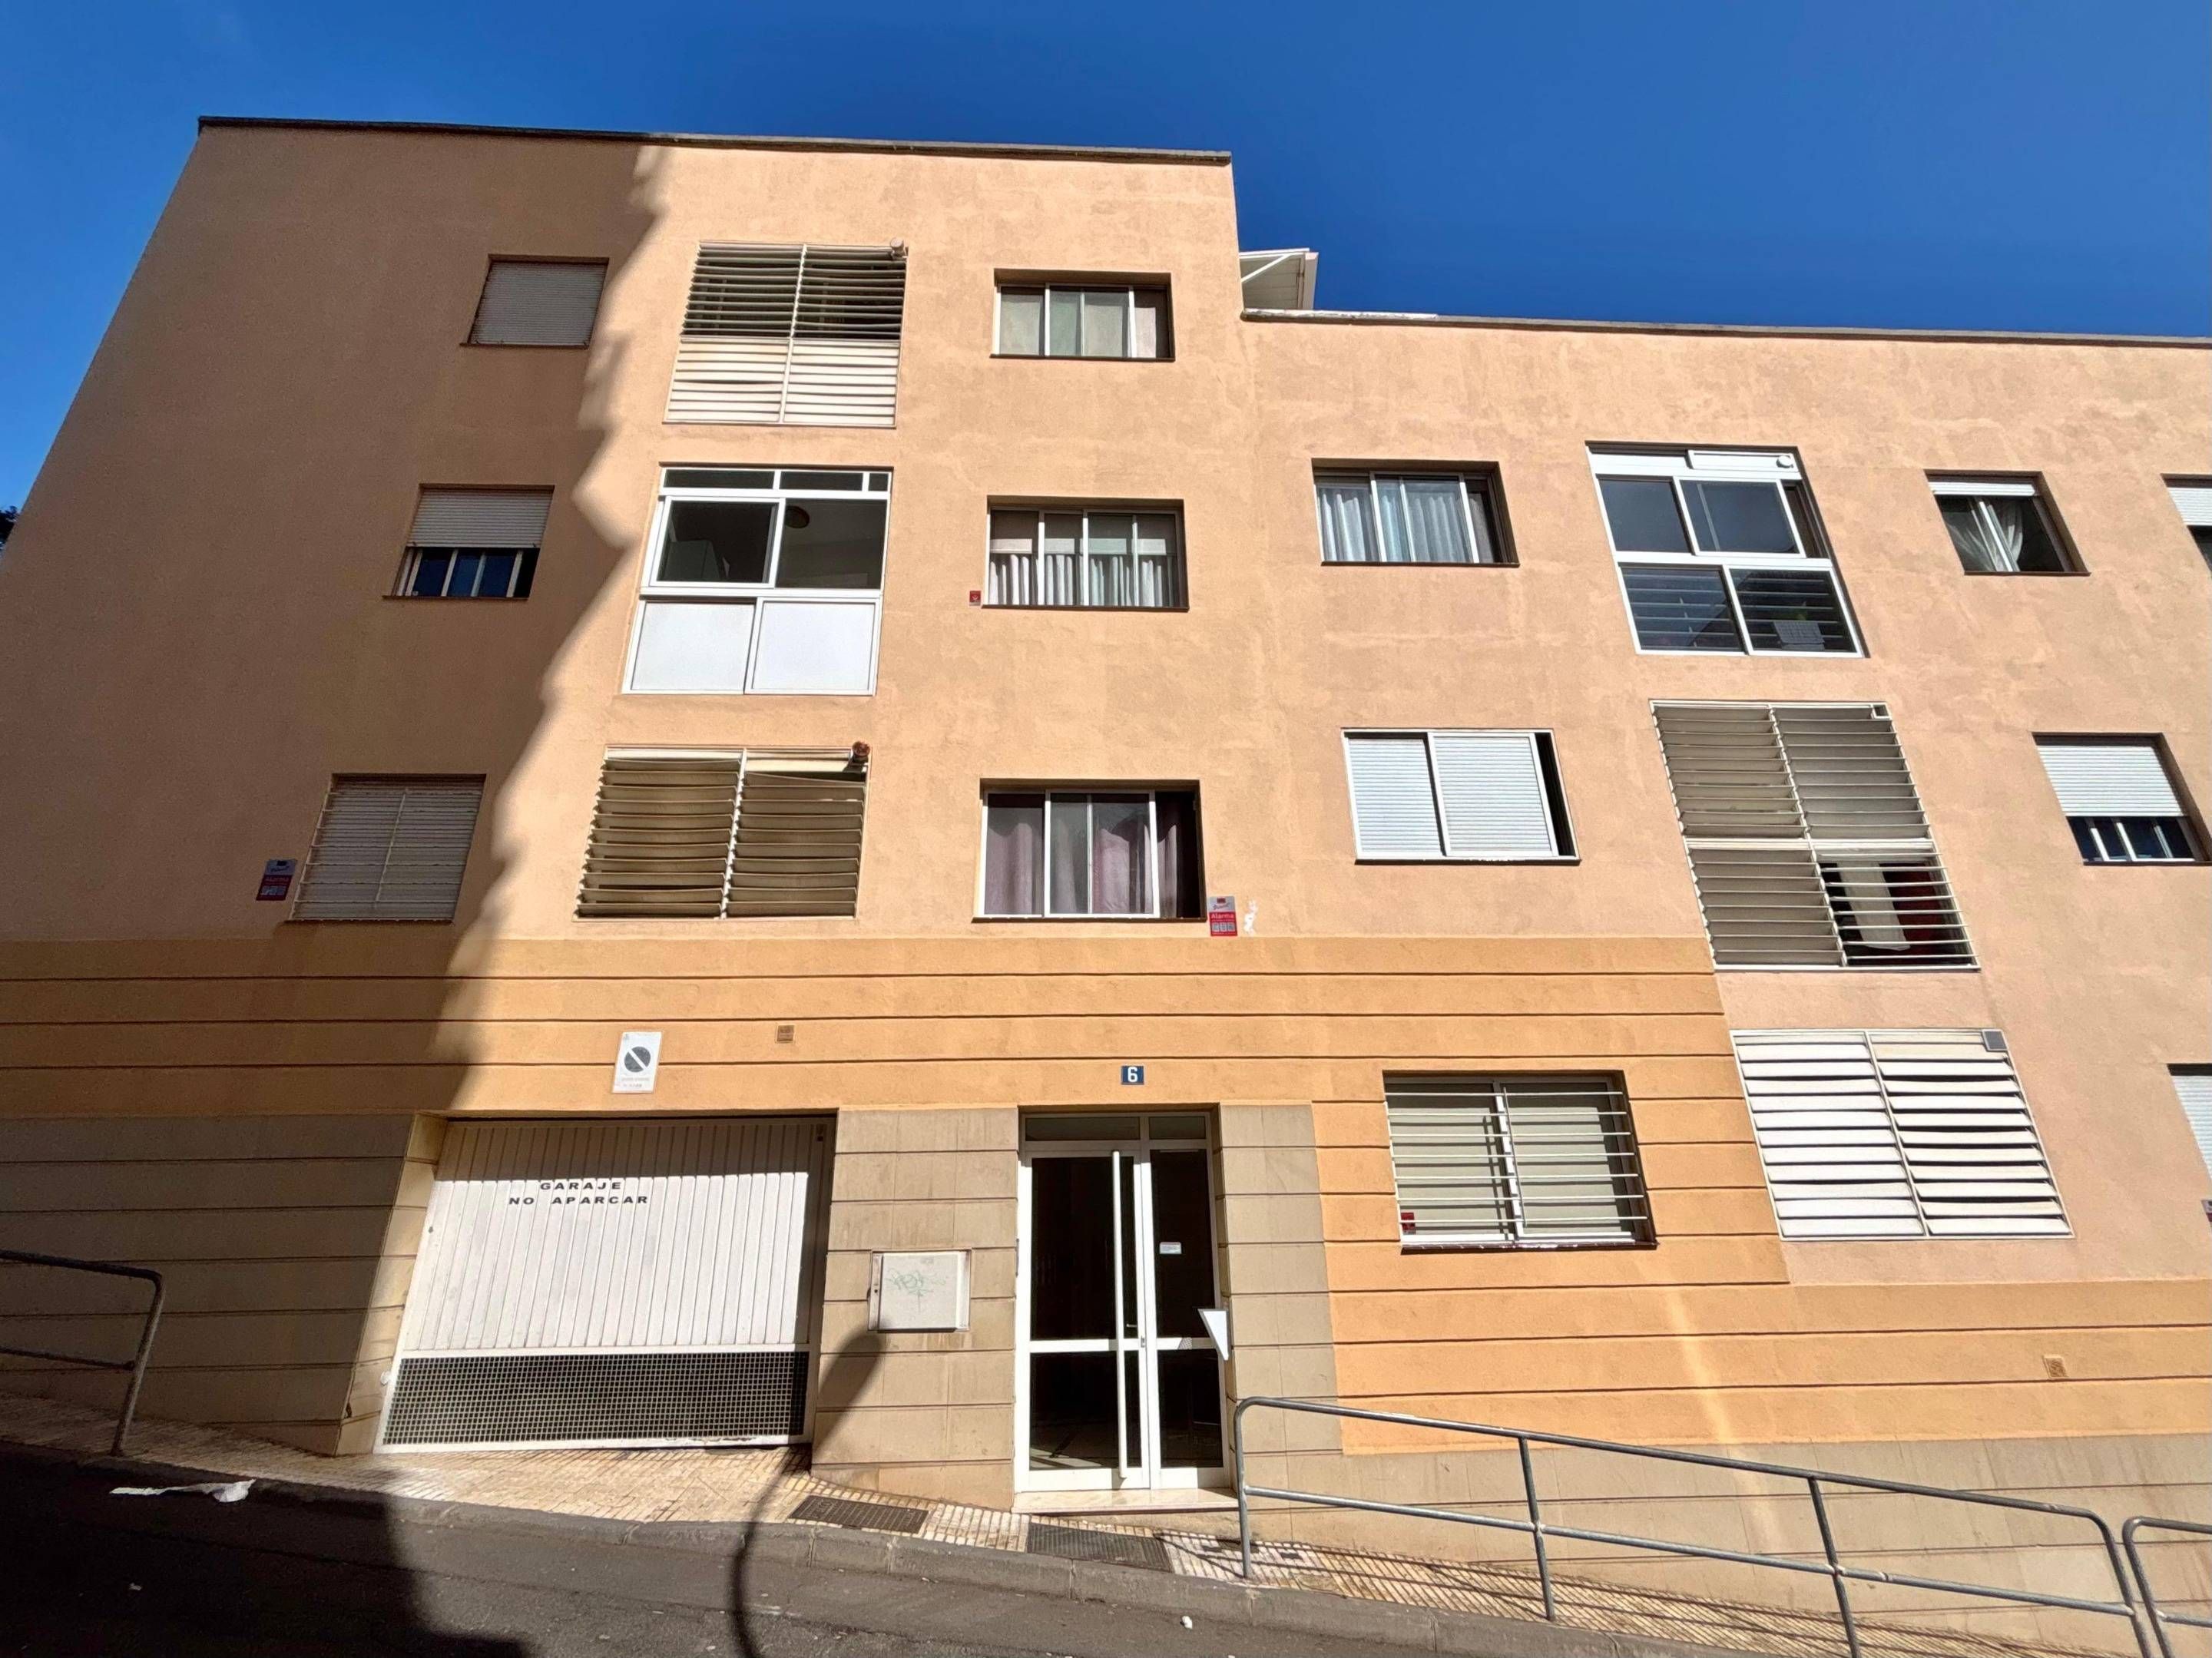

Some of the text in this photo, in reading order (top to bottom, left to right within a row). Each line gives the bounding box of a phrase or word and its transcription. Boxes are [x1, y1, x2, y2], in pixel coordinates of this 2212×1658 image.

[1128, 1066, 1138, 1083] 6
[540, 1182, 622, 1190] GARAJE
[508, 1196, 648, 1205] NO APARCAR
